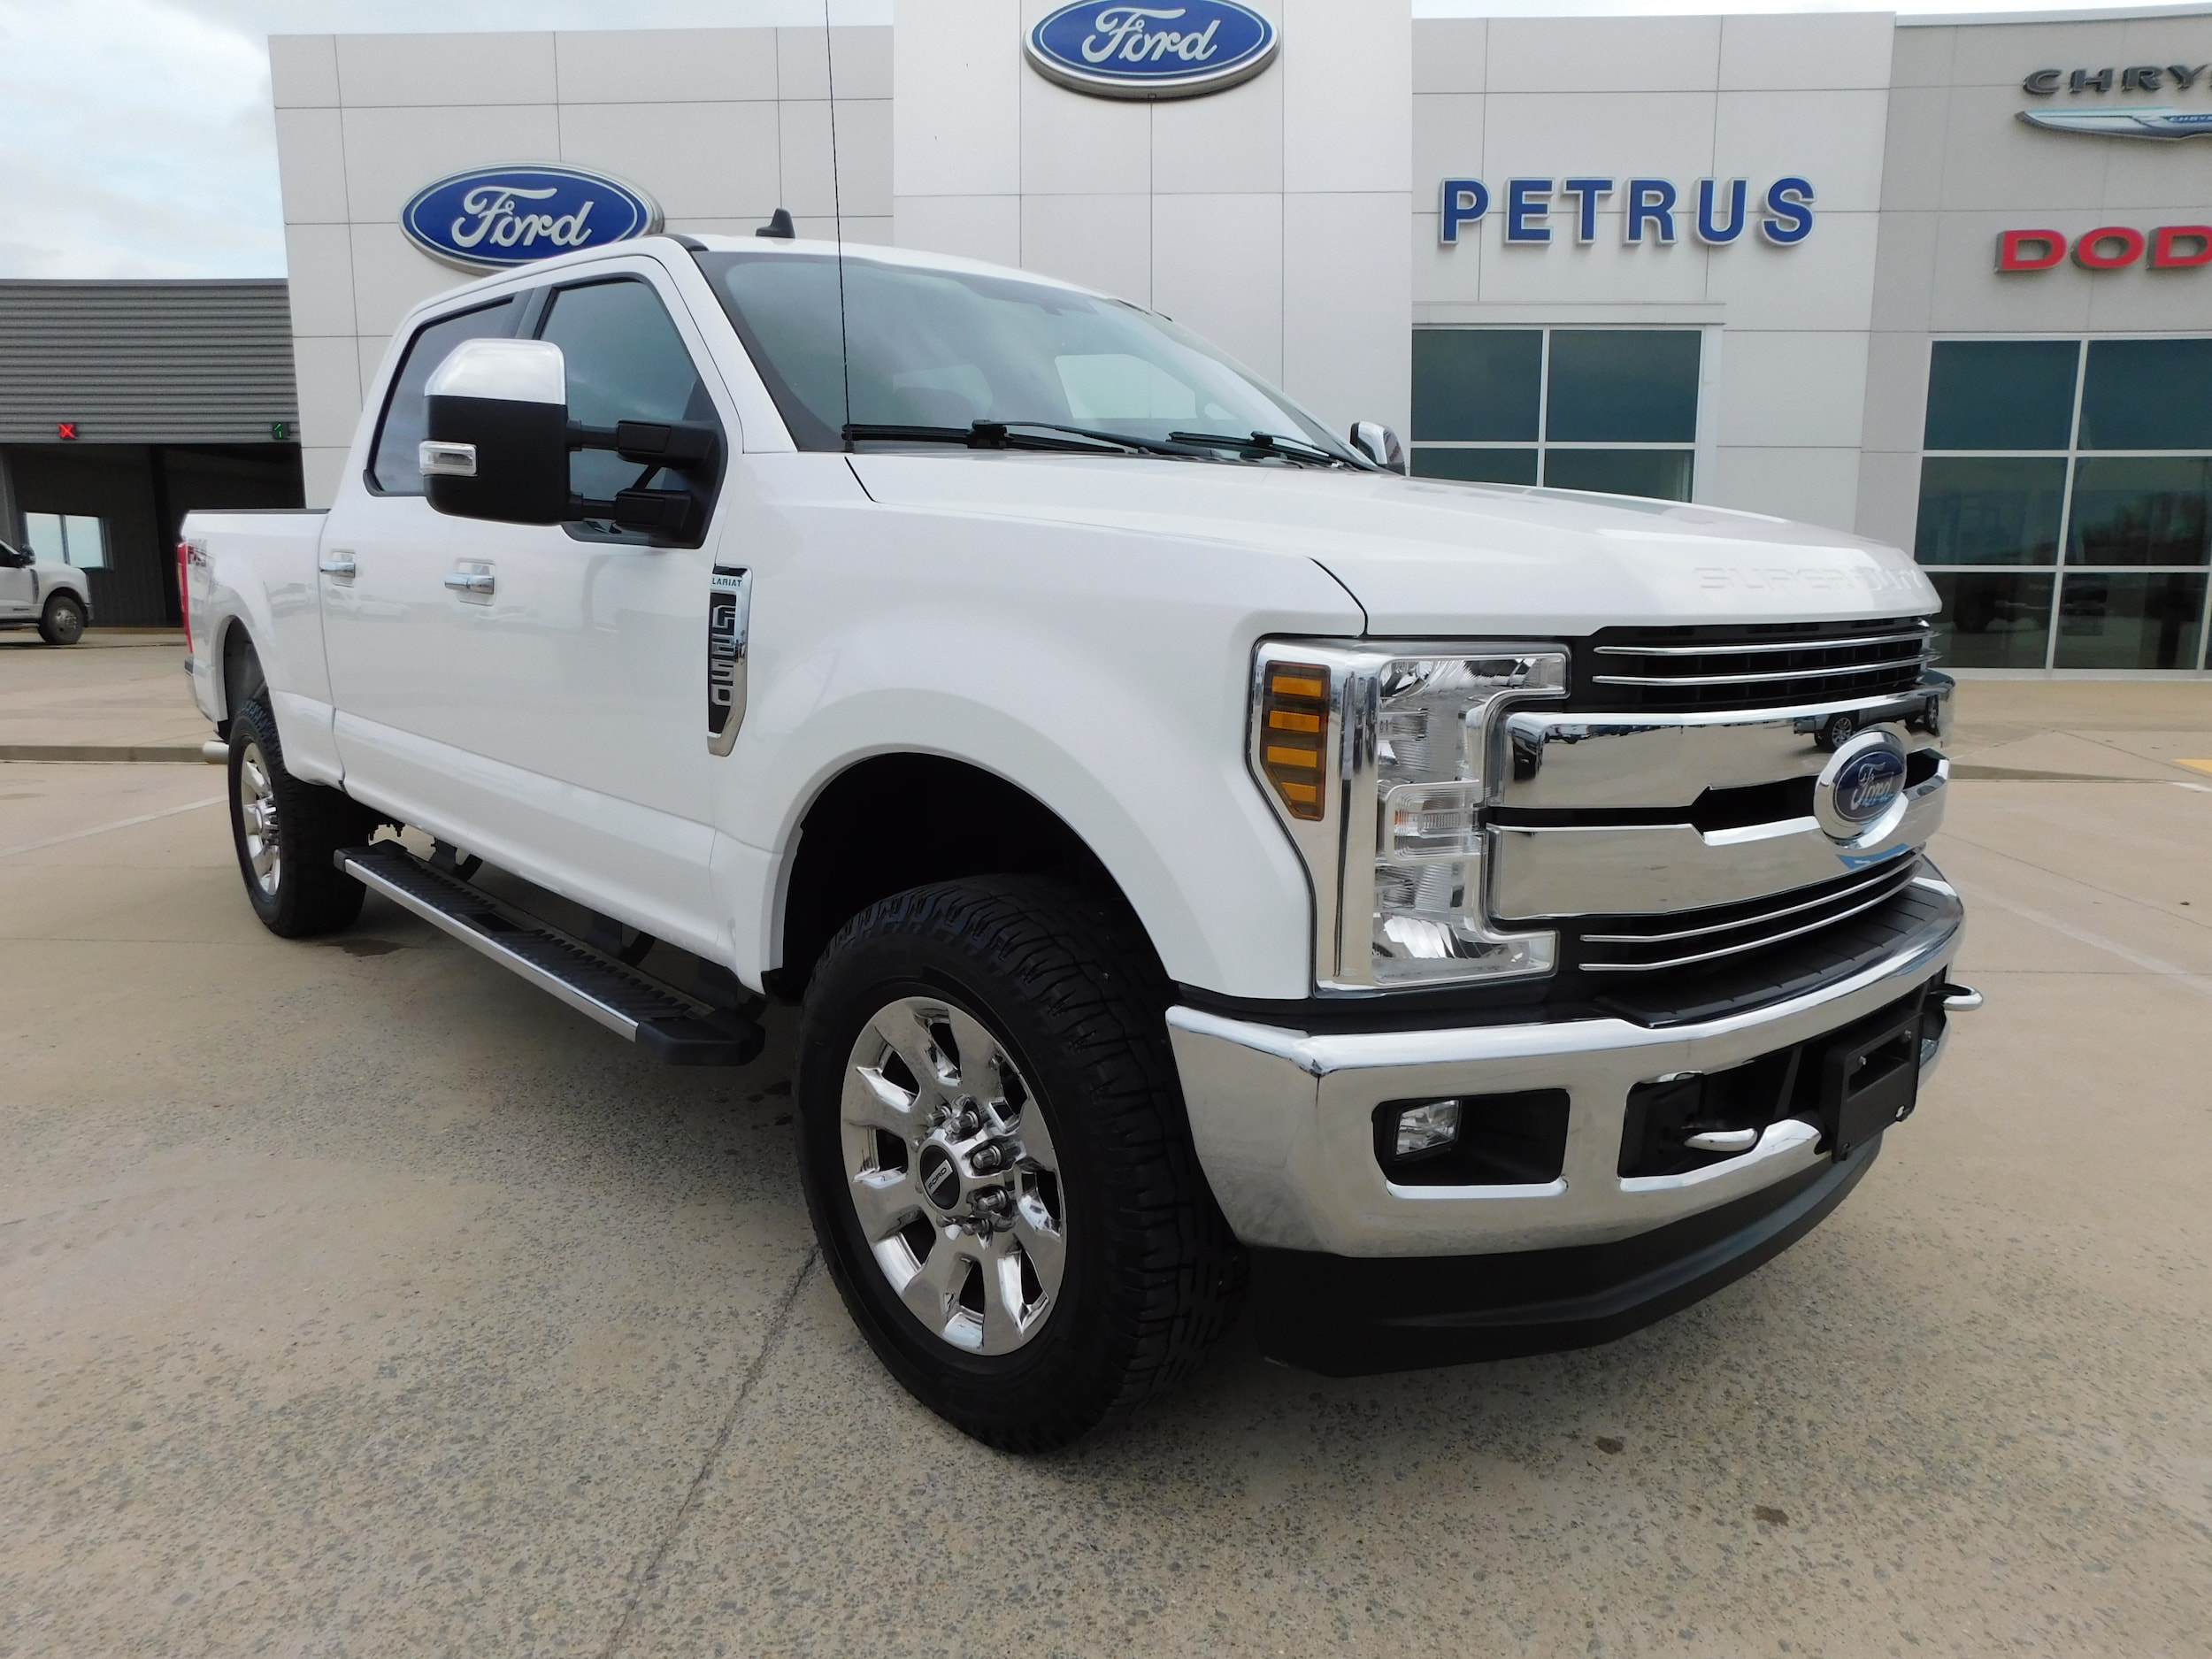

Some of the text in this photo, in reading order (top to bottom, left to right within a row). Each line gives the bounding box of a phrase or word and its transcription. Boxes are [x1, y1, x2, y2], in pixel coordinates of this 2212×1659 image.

[1081, 7, 1221, 63] Ford
[2023, 63, 2212, 95] CHRY
[451, 186, 595, 248] Ford
[1437, 175, 1817, 247] PETRUS
[1994, 225, 2212, 274] DOD
[711, 577, 742, 588] LARIAT
[1850, 761, 1895, 810] Ford
[928, 1167, 948, 1190] FORD
